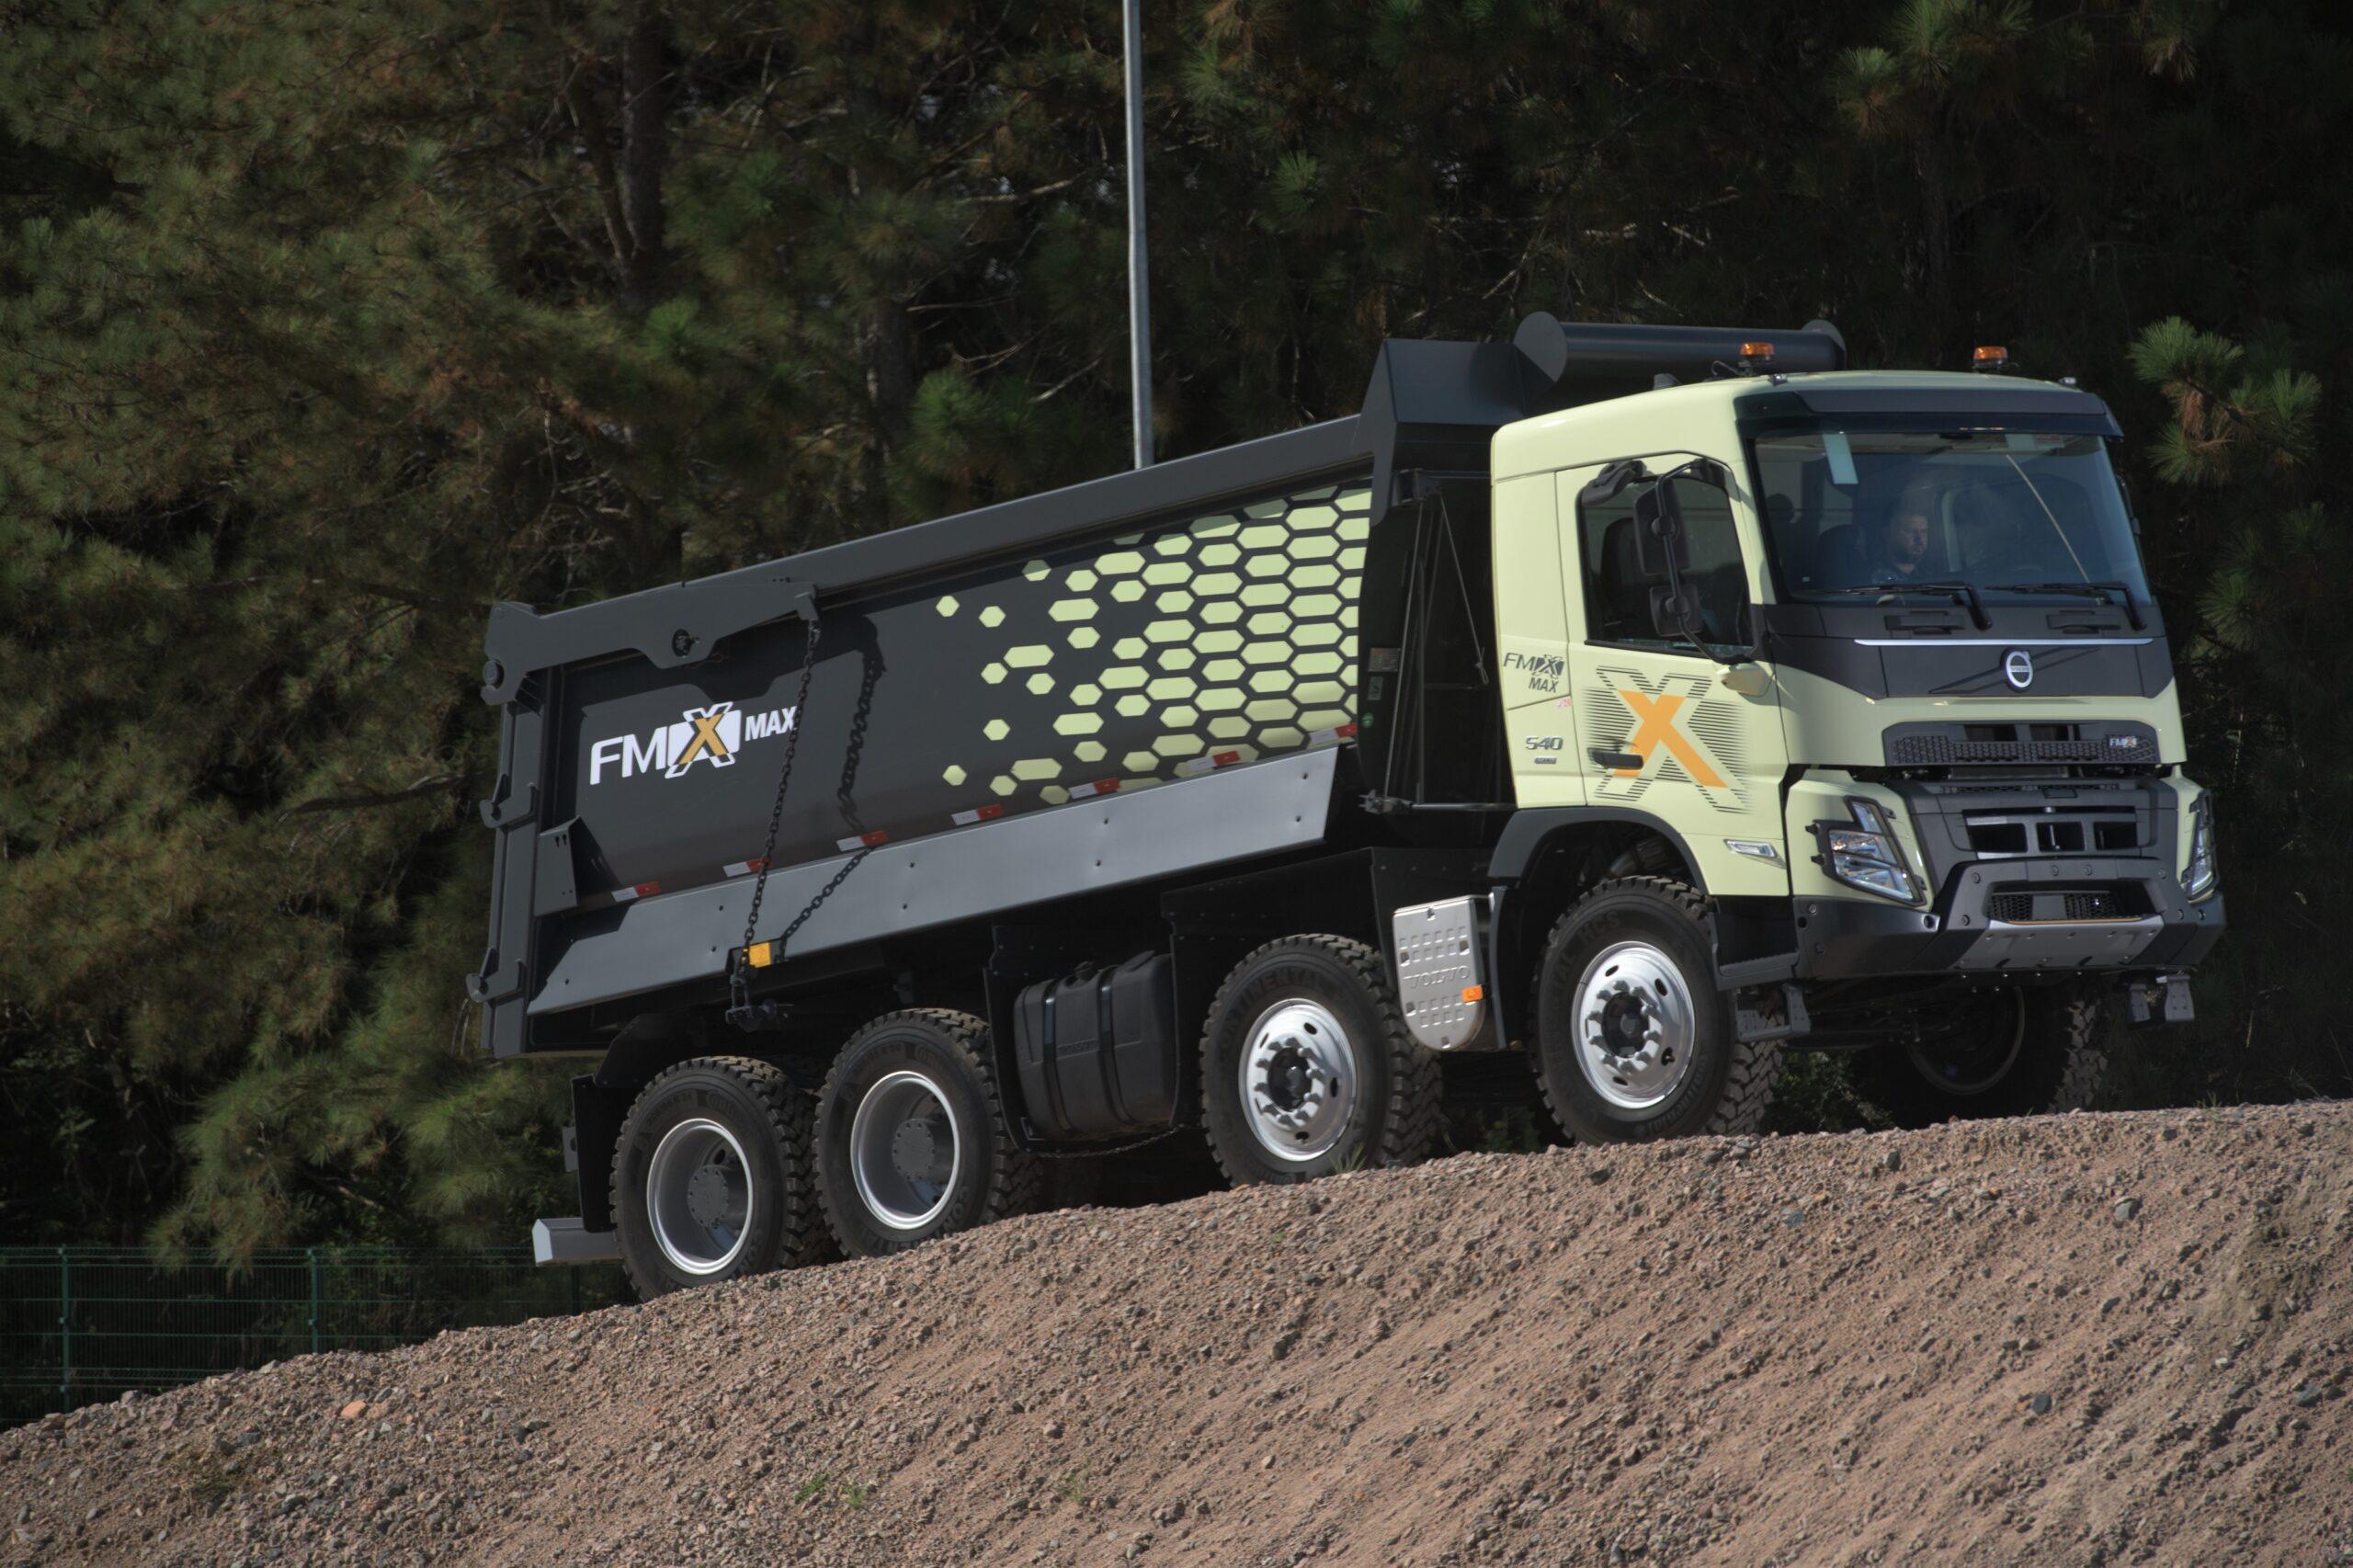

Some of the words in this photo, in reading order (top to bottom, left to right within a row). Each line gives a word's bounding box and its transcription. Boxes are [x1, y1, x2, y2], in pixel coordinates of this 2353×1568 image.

[1503, 653, 1565, 679] FMX
[1528, 676, 1559, 693] MAX
[589, 701, 741, 785] FMX
[745, 706, 798, 742] MAX
[1526, 736, 1563, 750] 540
